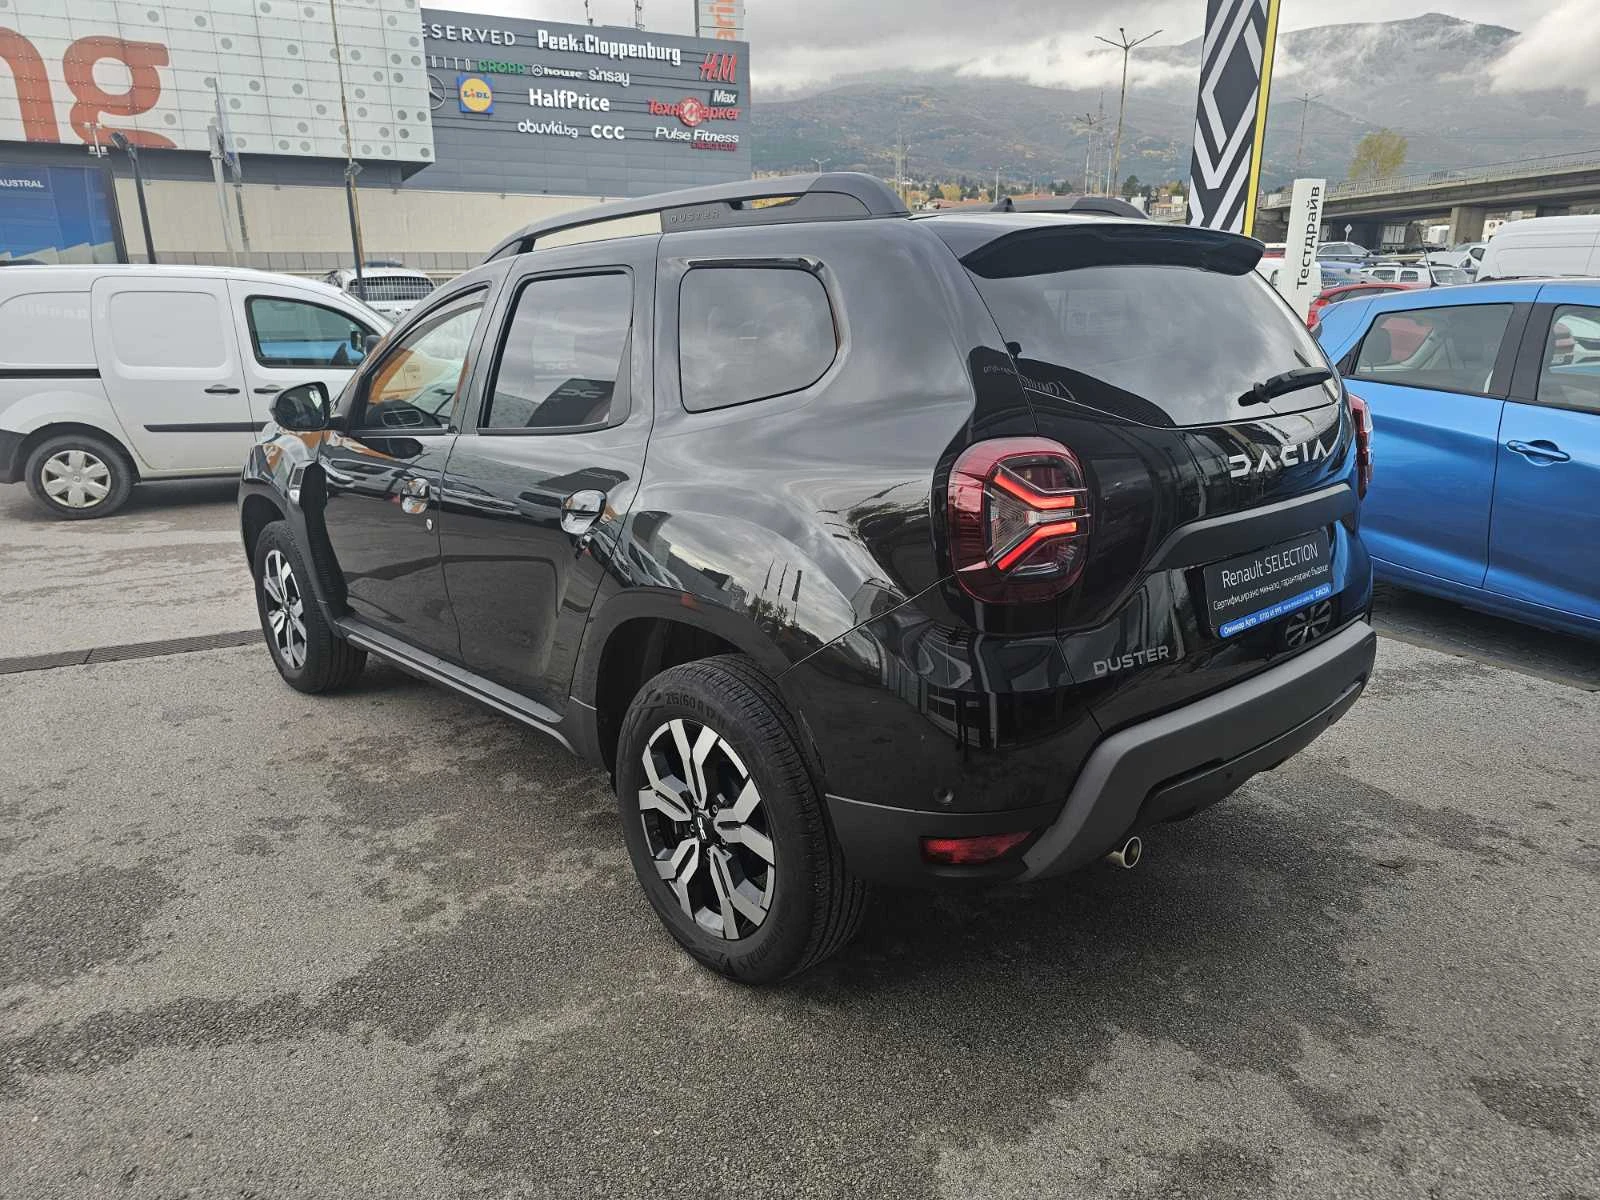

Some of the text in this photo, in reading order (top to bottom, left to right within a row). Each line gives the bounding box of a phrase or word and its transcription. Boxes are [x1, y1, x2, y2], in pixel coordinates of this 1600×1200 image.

[529, 88, 610, 111] HalfPrice
[713, 90, 737, 104] Max
[517, 118, 579, 138] obuvki.bg
[591, 124, 625, 139] CCC
[656, 127, 739, 143] Pulse Fitness
[1297, 186, 1320, 290] Тестдрайв
[1229, 439, 1328, 478] DACIA
[1221, 542, 1319, 589] Renault SELECTION
[1093, 645, 1170, 675] DUSTER
